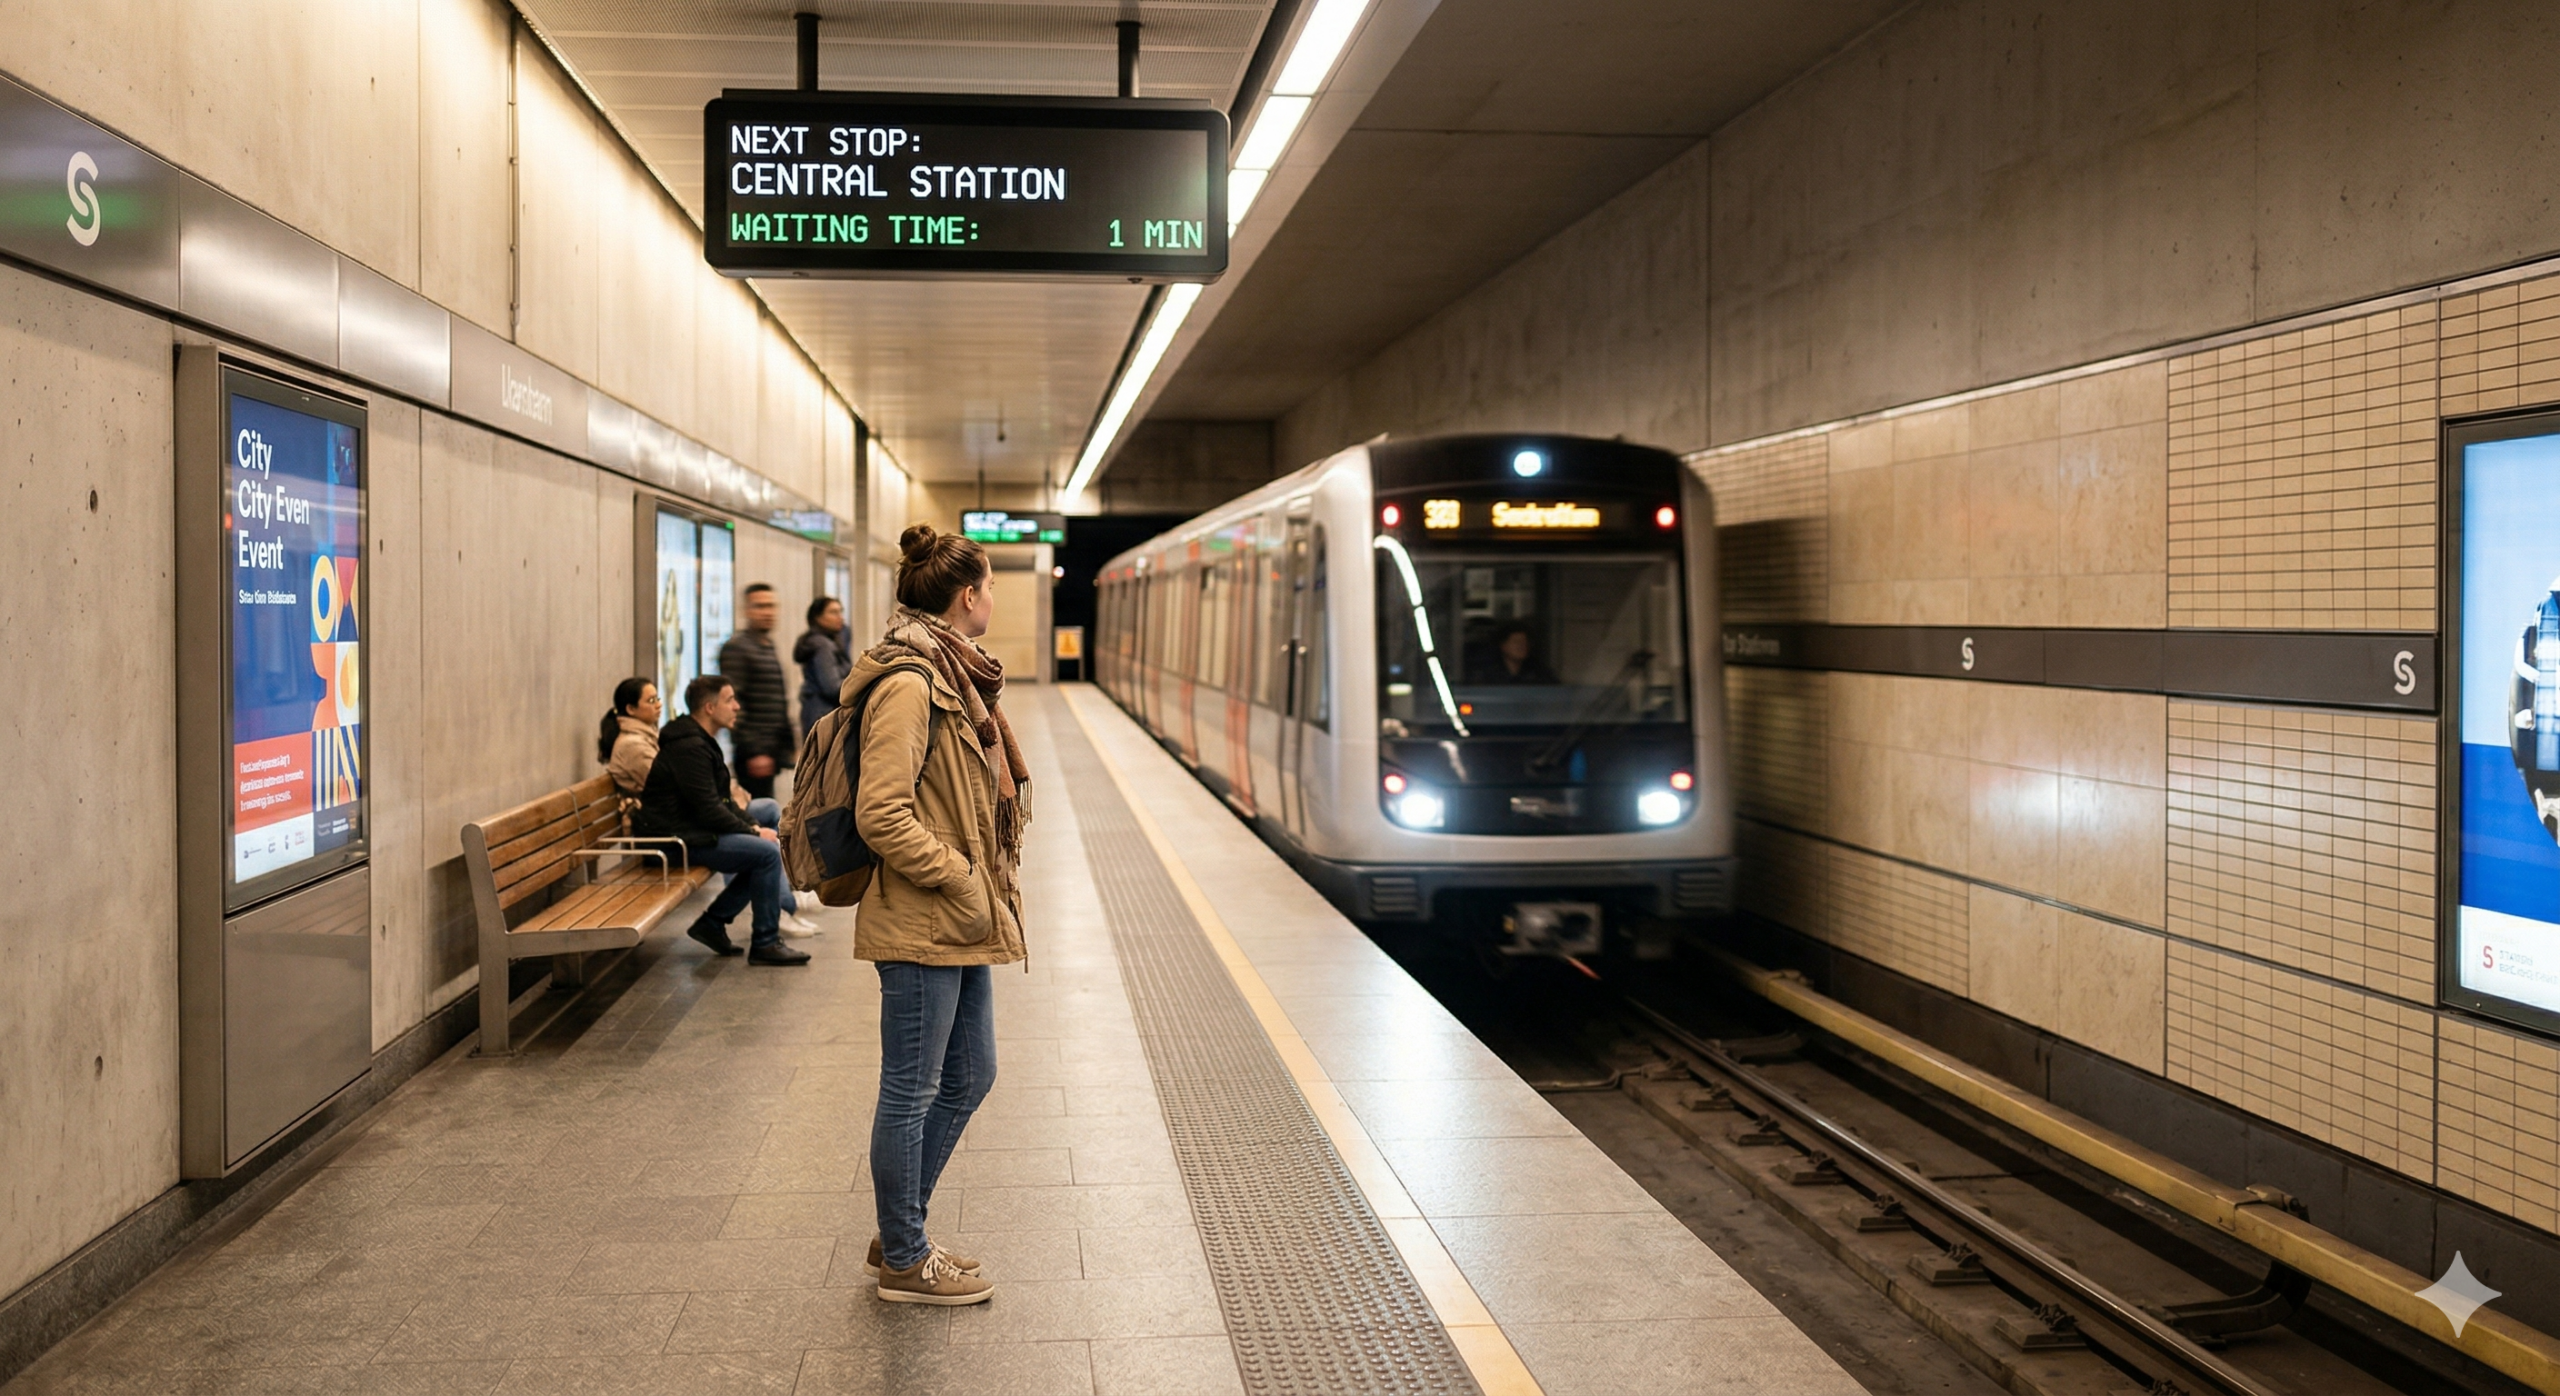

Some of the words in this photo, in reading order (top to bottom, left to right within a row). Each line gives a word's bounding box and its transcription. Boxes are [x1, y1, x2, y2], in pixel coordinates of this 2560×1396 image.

[731, 125, 809, 155] NEXT
[829, 127, 921, 157] STOP:
[66, 151, 101, 247] S
[731, 162, 888, 197] CENTRAL
[909, 166, 1065, 201] STATION
[731, 212, 869, 243] WAITING
[888, 216, 979, 245] TIME:
[1109, 219, 1124, 247] 1
[1145, 221, 1203, 249] MIN
[237, 428, 272, 480] City
[238, 479, 272, 530] City
[276, 485, 310, 525] Even
[239, 529, 284, 570] Event
[1961, 637, 1974, 671] S
[2393, 651, 2417, 697] S
[2482, 945, 2493, 969] S
